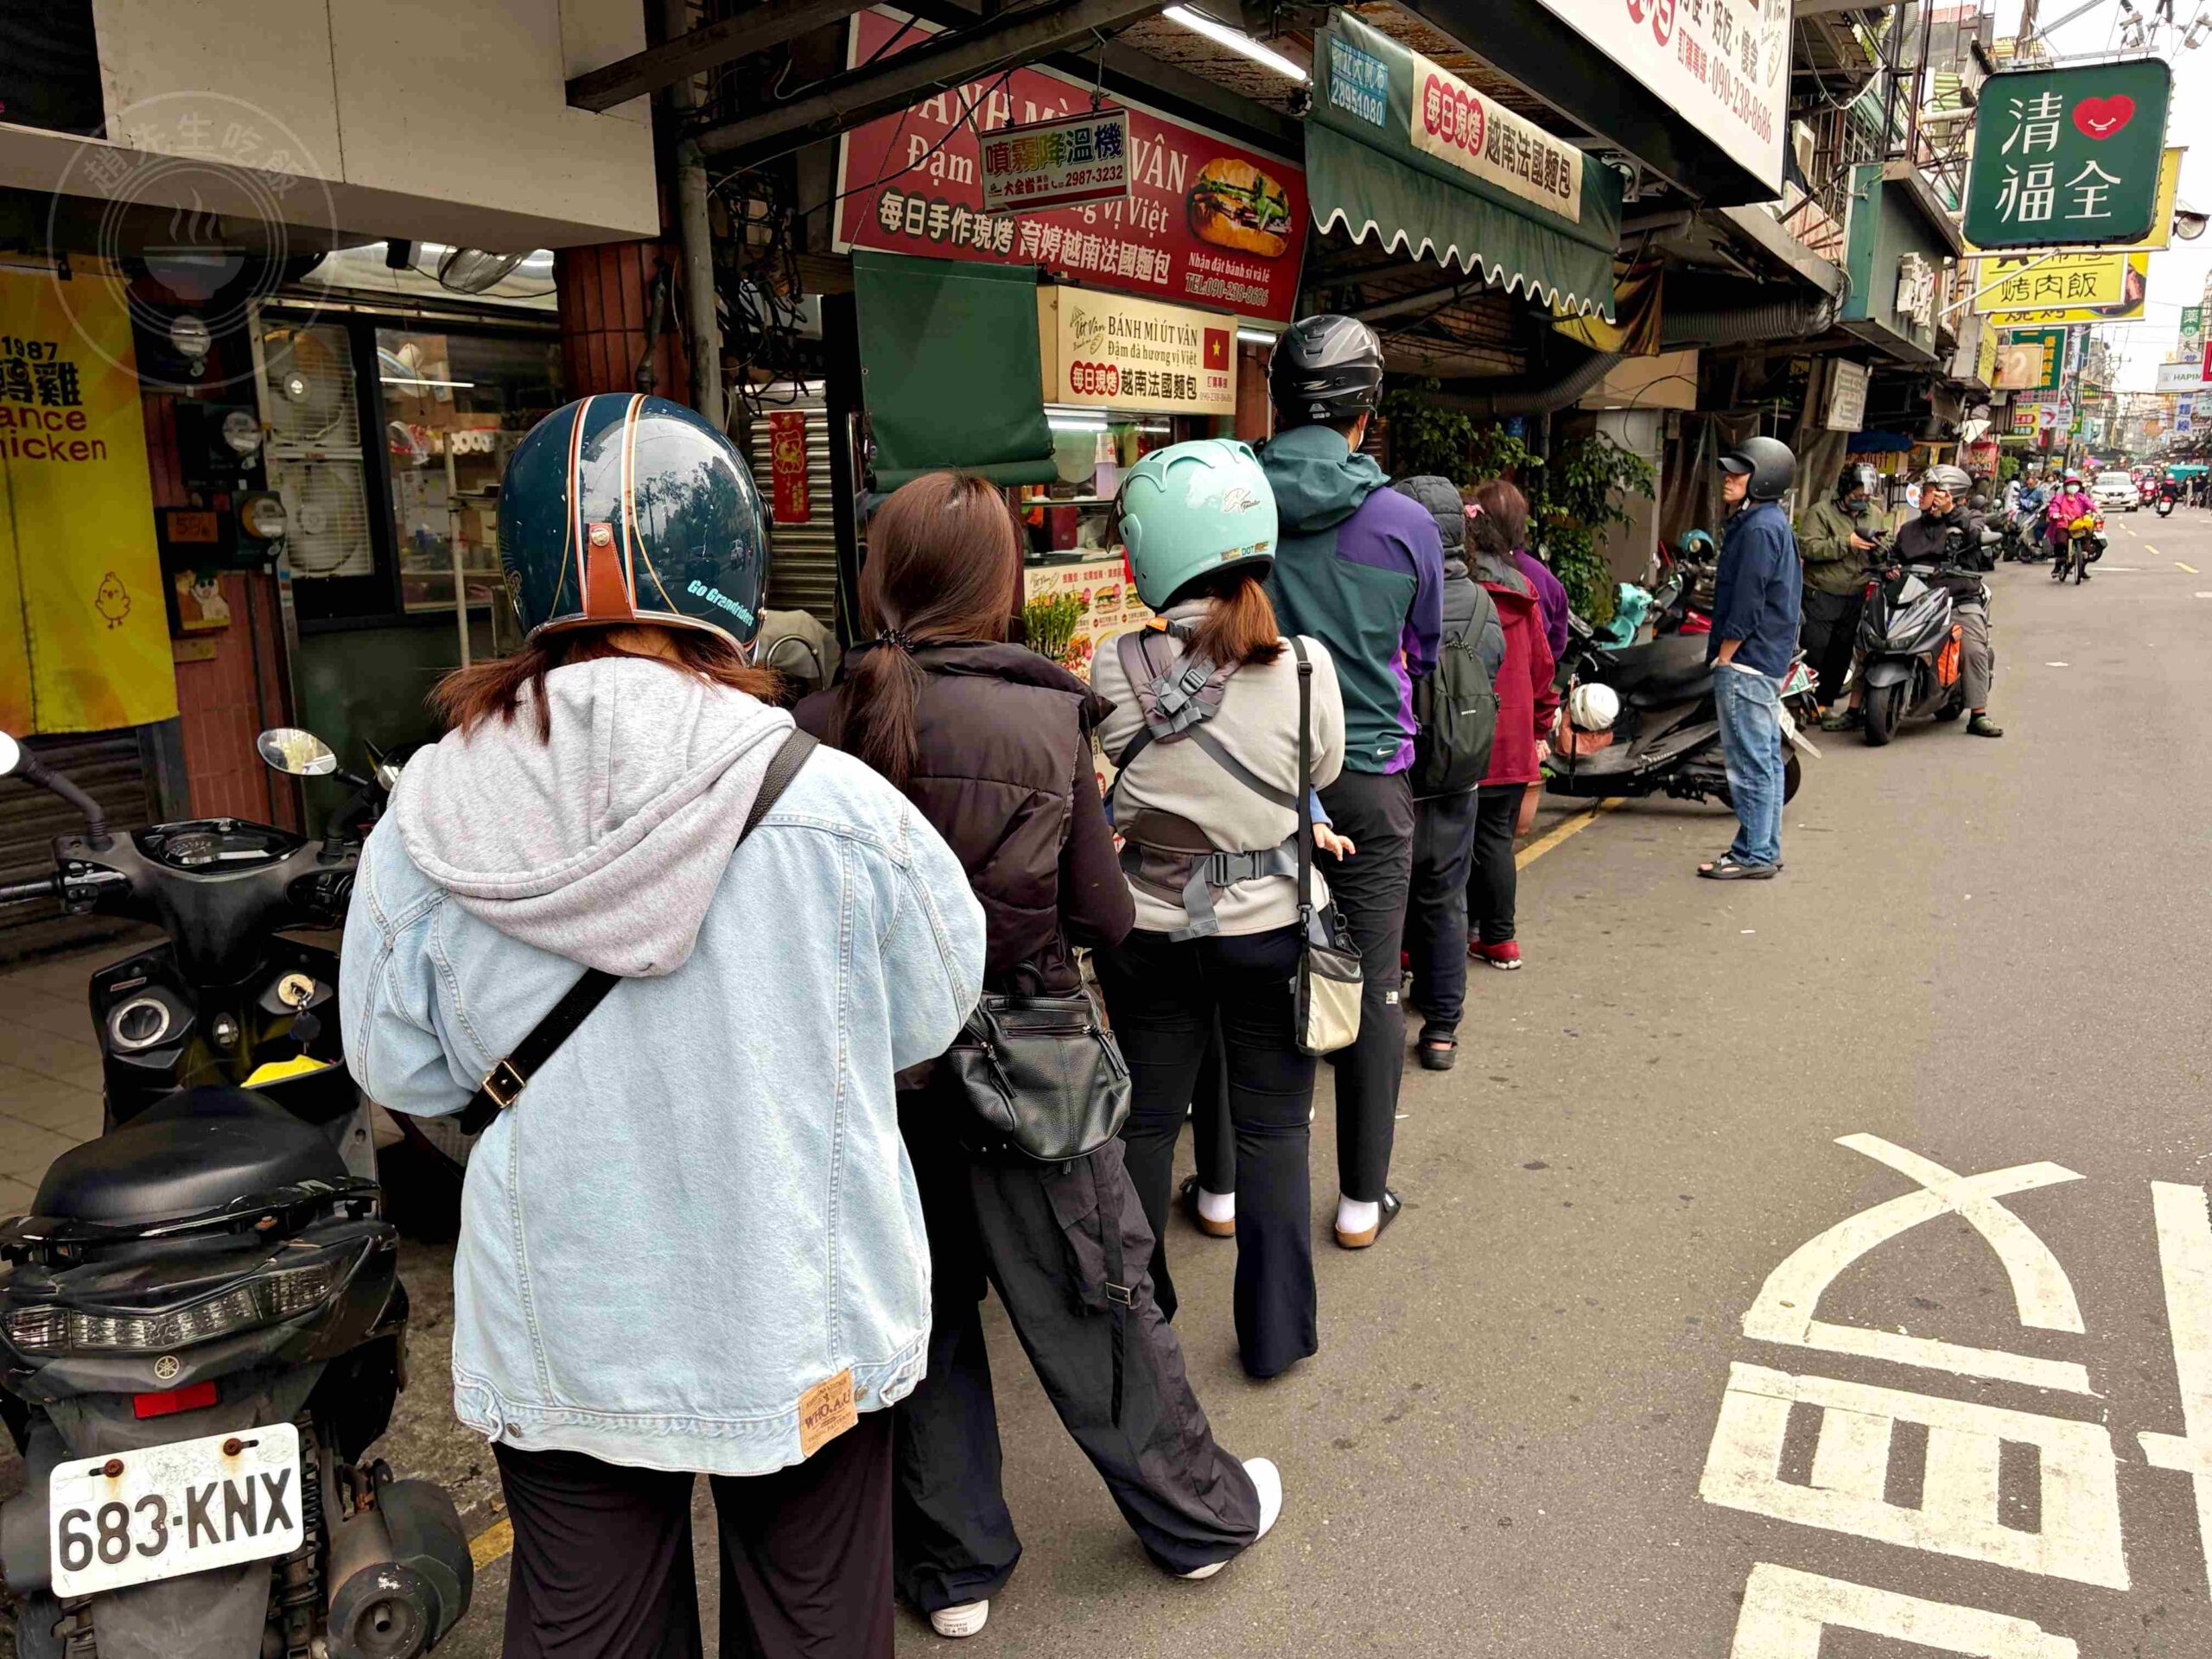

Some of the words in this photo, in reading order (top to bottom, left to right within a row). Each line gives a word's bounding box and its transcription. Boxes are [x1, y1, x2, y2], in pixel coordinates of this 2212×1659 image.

[1331, 77, 1382, 127] 28951080
[985, 122, 1124, 176] 噴霧降溫機
[1130, 133, 1189, 194] VÂN
[1426, 84, 1483, 151] 每日現烤
[1484, 112, 1571, 200] 越南法國麵包
[1065, 164, 1123, 188] 2987-3232
[880, 191, 1014, 253] 每日手作現烤
[1019, 219, 1171, 285] 育婷越南法國麵包
[1129, 195, 1169, 238] Việt
[2000, 271, 2098, 303] 烤肉飯
[2, 335, 58, 360] 1987
[1109, 312, 1141, 340] BÁNH
[1144, 318, 1158, 342] MÌ
[1160, 319, 1175, 344] ÚT
[1177, 323, 1198, 347] VÂN
[1072, 366, 1118, 390] 每日現烤
[1121, 366, 1198, 400] 越南法國麵包
[687, 579, 708, 597] Go
[705, 588, 754, 627] Grandriders
[59, 1467, 294, 1572] 683-KNX
